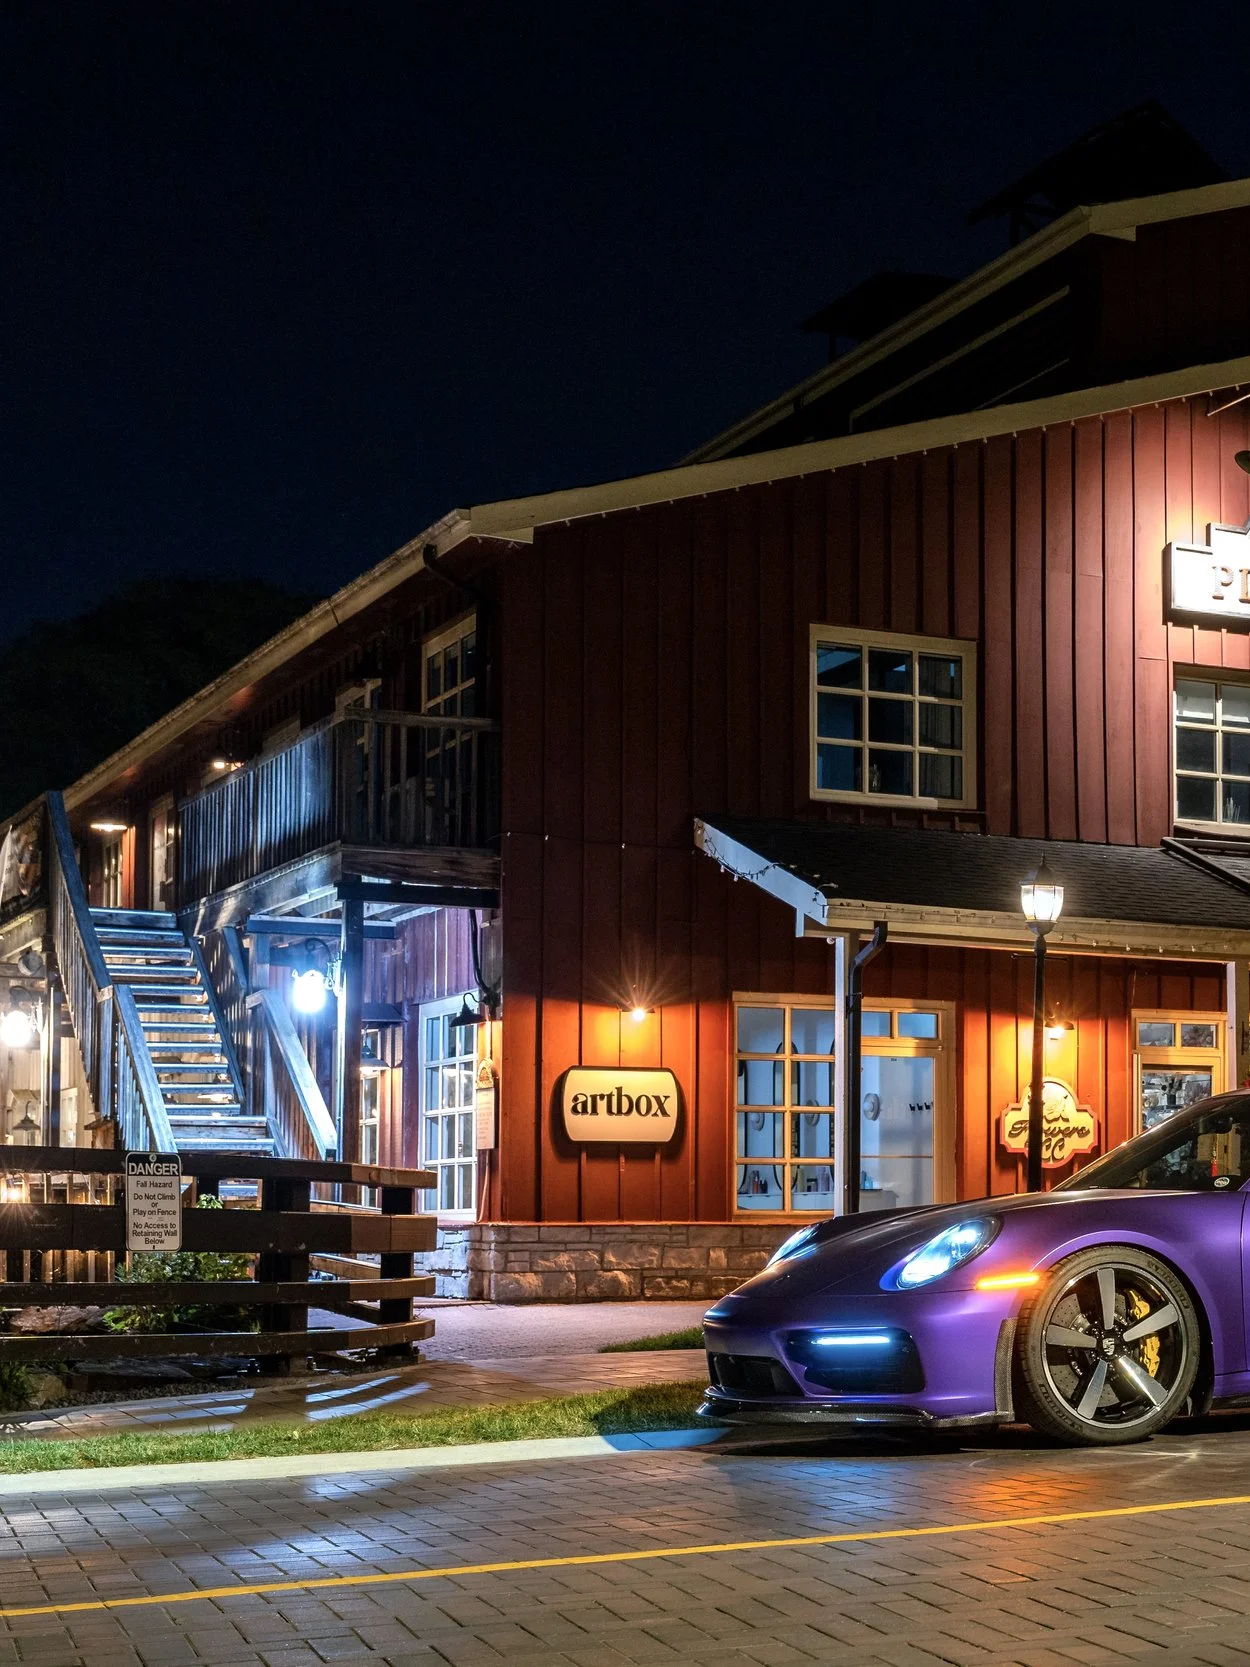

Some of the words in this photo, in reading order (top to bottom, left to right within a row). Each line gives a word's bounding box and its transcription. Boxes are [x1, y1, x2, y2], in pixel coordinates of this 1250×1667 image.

[571, 1086, 671, 1117] artbox
[128, 1162, 179, 1175] DANGER
[132, 1209, 146, 1217] Play
[132, 1230, 163, 1238] Retaining
[144, 1237, 165, 1245] Below
